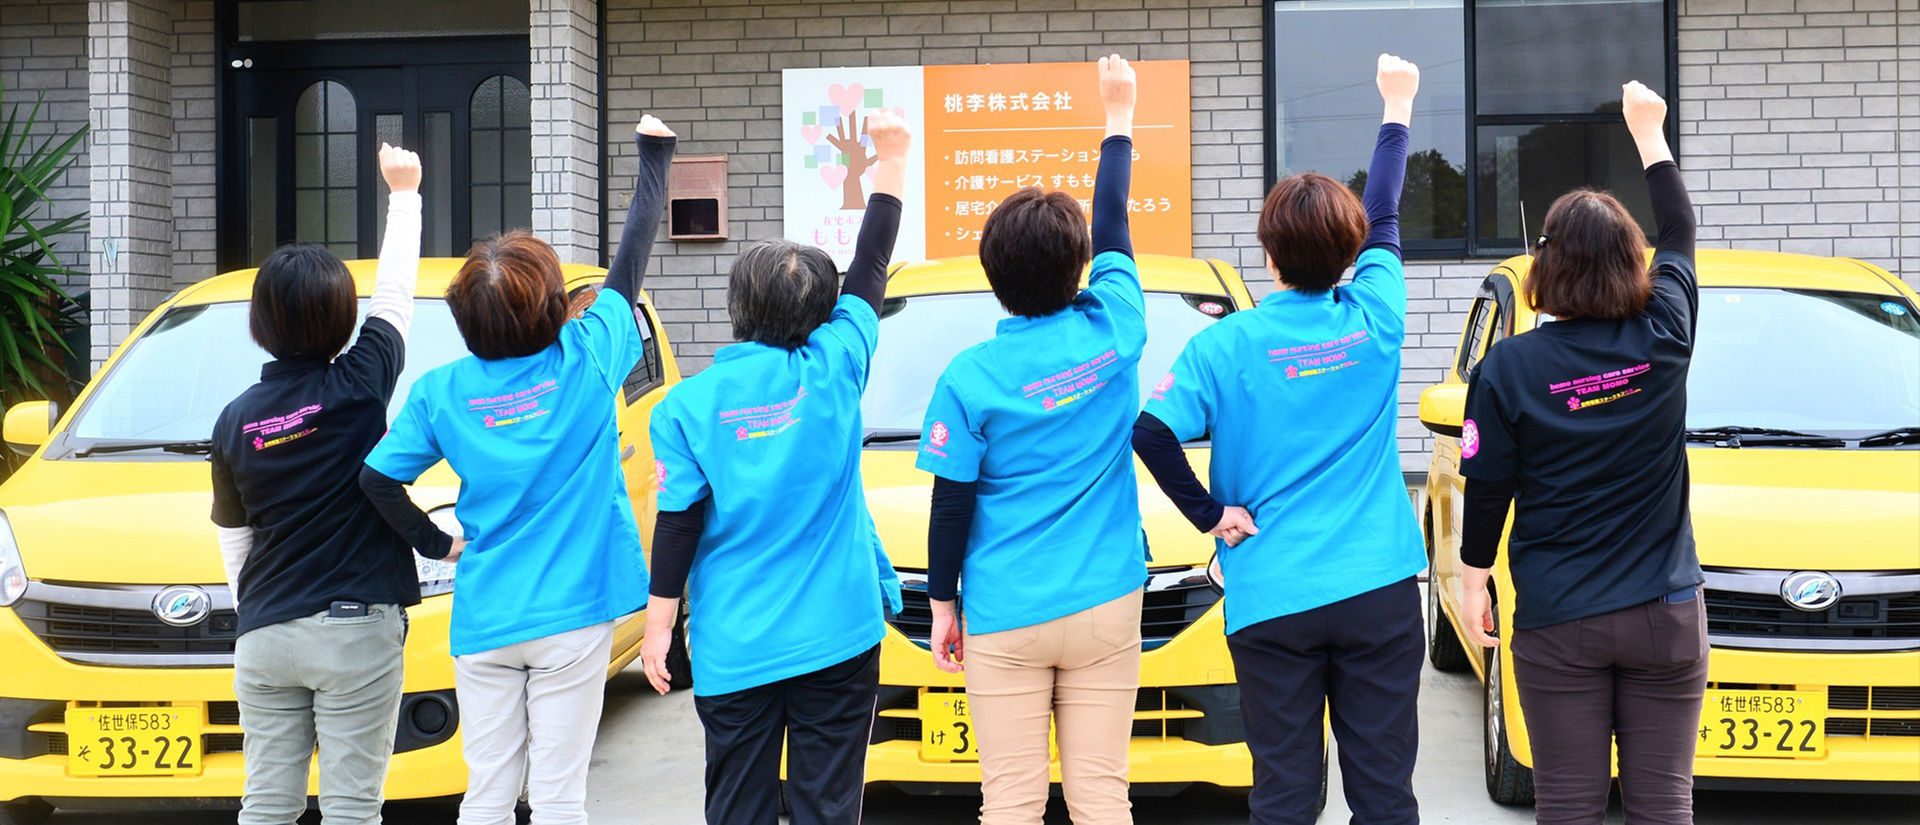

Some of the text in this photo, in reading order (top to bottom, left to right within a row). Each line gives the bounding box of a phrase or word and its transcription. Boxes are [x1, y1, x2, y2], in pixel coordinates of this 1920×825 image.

[944, 91, 1072, 113] 桃李株式会社
[1321, 340, 1339, 349] care
[1298, 358, 1320, 367] TEAM
[1043, 370, 1073, 385] nursing
[1073, 363, 1090, 374] care
[1549, 363, 1651, 390] home nursing care service
[1052, 384, 1075, 397] TEAM
[1575, 379, 1629, 395] TEAM MOMO
[494, 408, 515, 417] TEAM
[260, 425, 282, 436] TEAM
[747, 420, 770, 429] TEAM
[953, 699, 968, 716] 佐
[931, 722, 975, 754] け 3
[1698, 718, 1816, 751] す 33-22
[78, 736, 193, 769] そ 33-22
